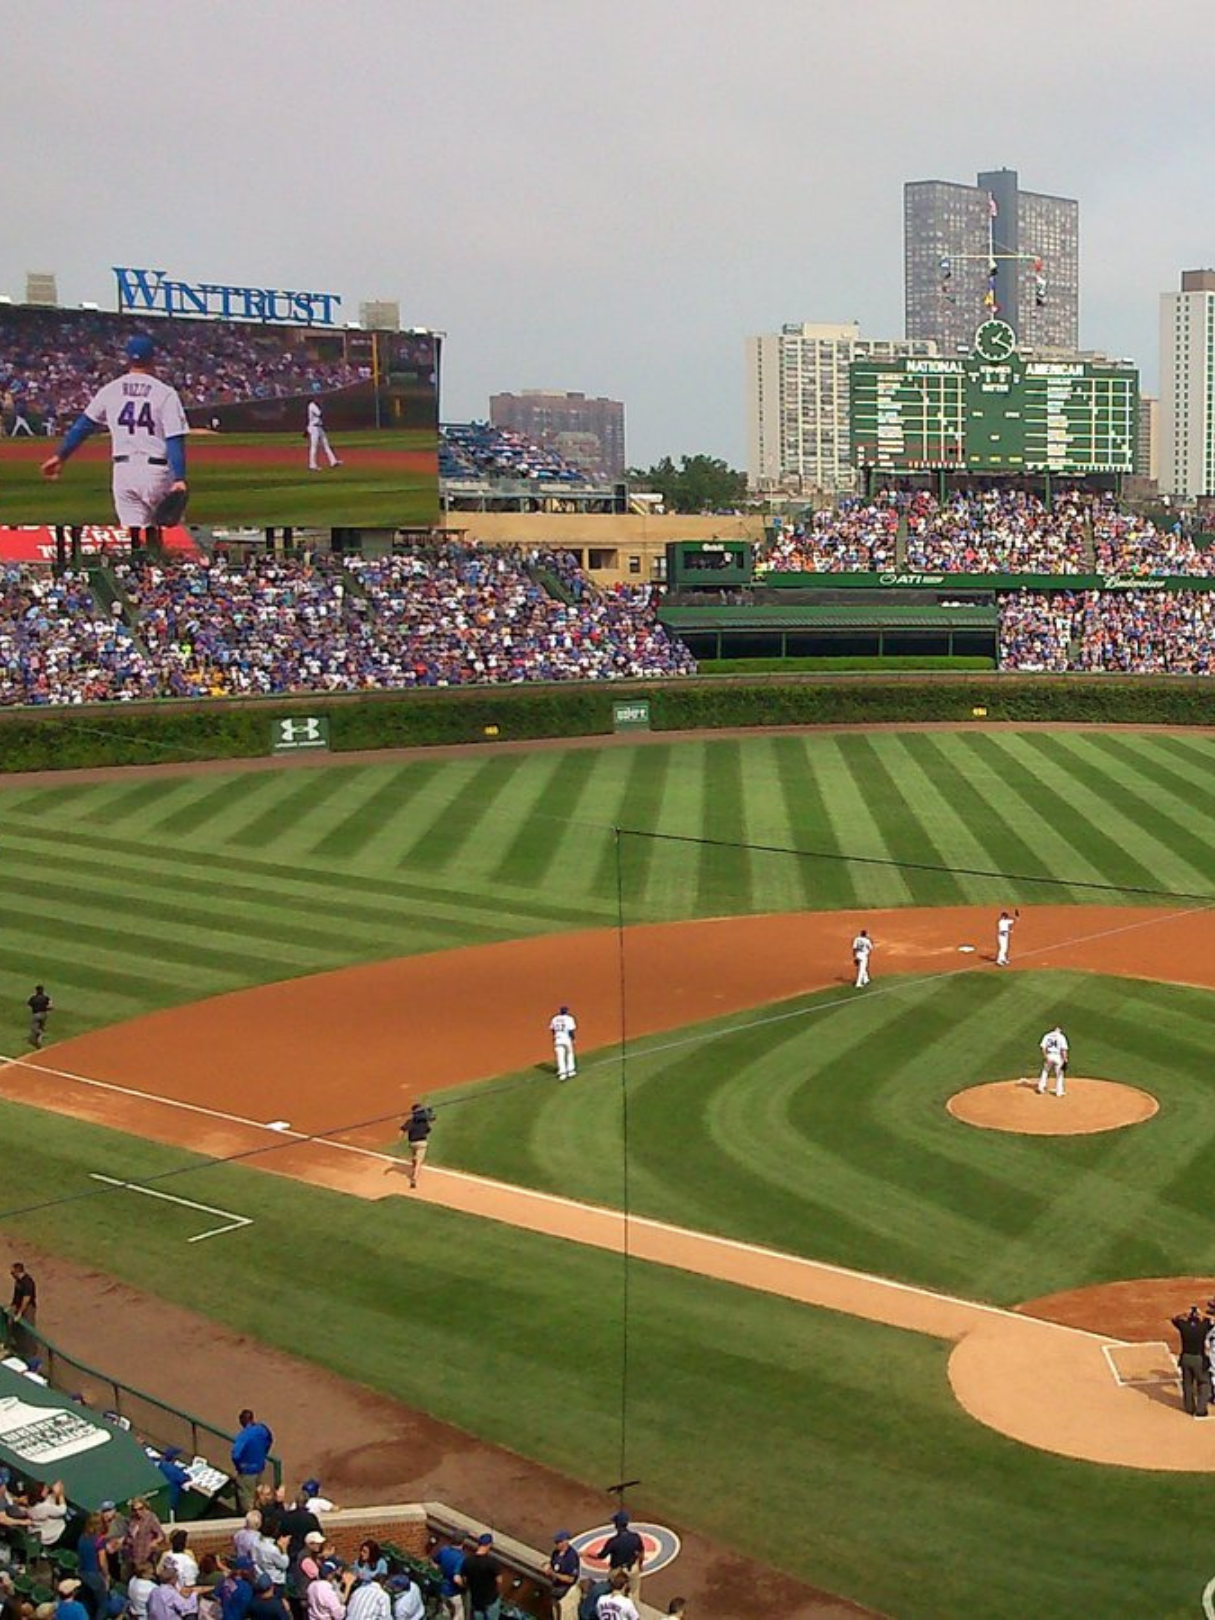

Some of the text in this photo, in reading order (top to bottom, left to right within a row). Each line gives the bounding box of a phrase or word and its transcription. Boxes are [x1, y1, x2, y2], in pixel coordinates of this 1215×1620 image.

[112, 267, 342, 325] WINTRUST
[906, 360, 966, 374] NATIONAL
[1025, 363, 1084, 375] AMERICAN
[117, 401, 156, 436] 44
[896, 574, 922, 584] ATI
